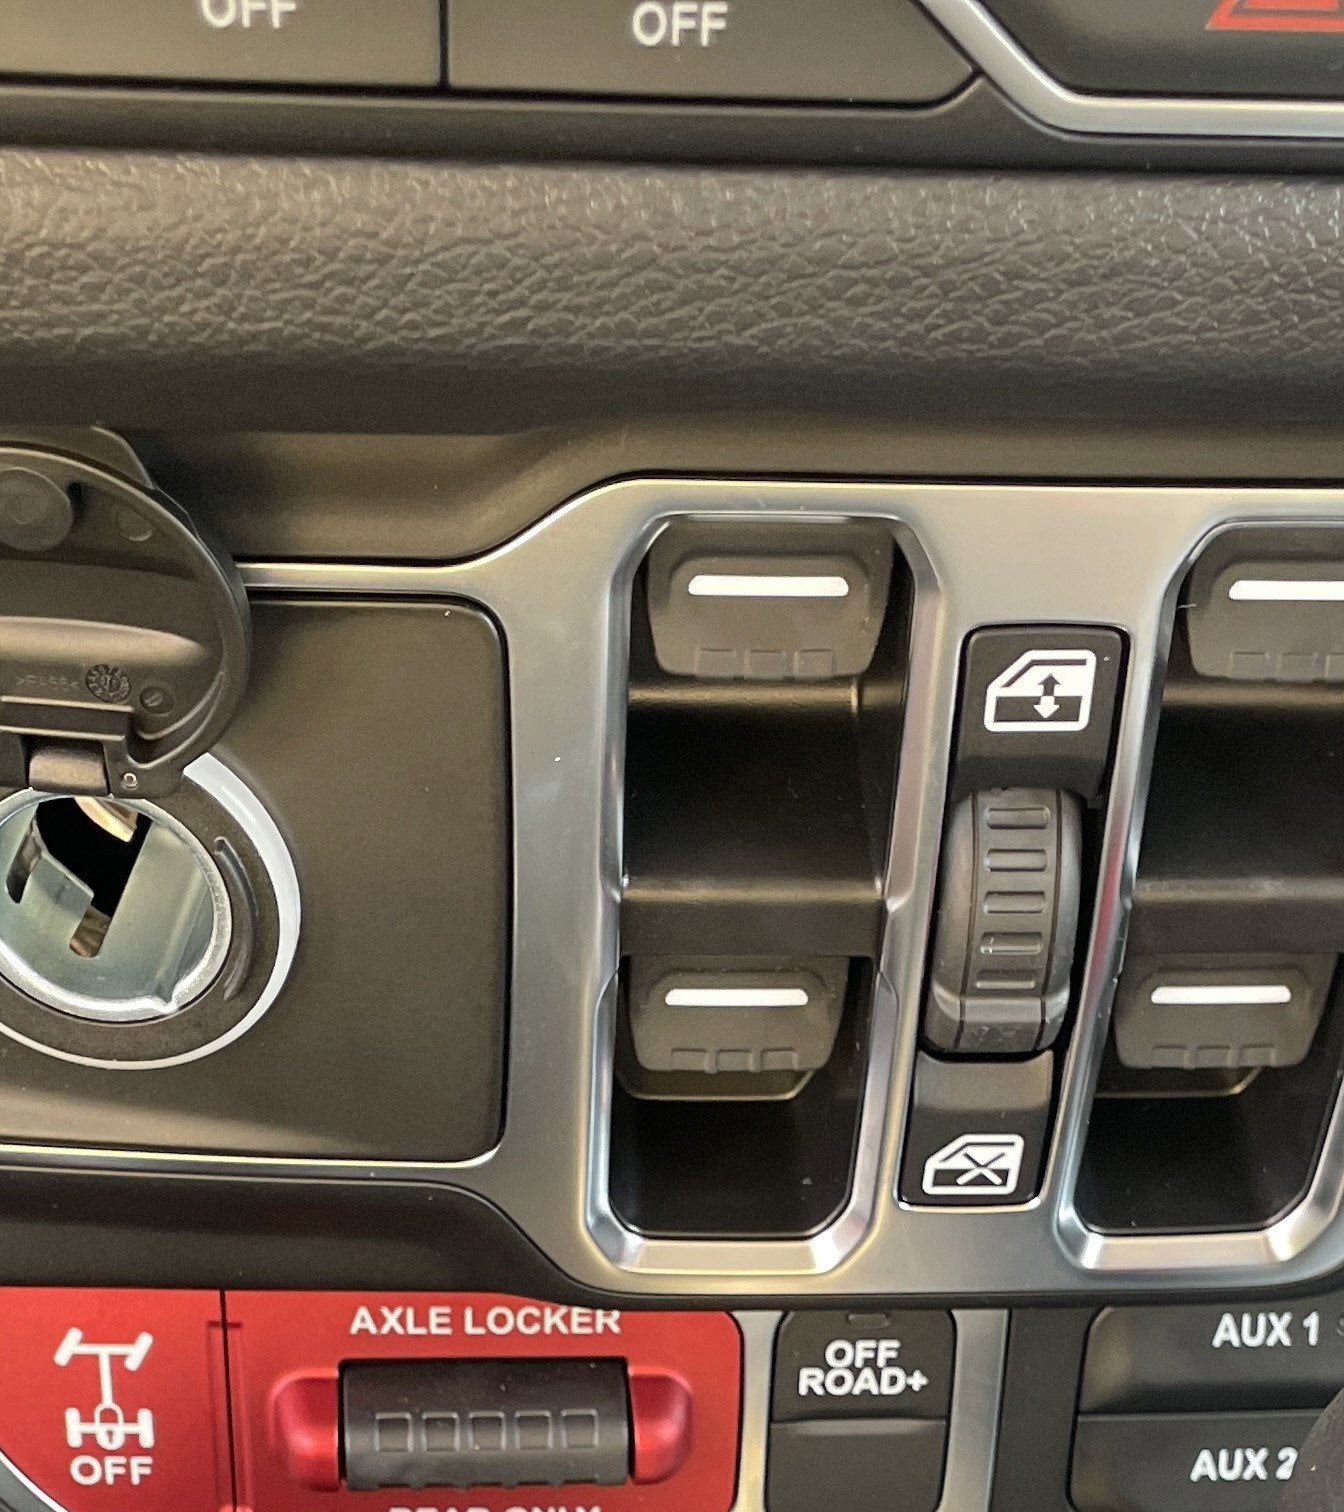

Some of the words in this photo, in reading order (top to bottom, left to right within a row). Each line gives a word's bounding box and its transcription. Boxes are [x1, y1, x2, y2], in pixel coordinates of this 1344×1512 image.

[202, 0, 296, 28] OFF
[632, 1, 728, 46] OFF
[349, 1306, 453, 1335] AXLE
[464, 1306, 620, 1335] LOCKER
[1212, 1312, 1293, 1348] AUX
[1303, 1311, 1320, 1346] 1
[824, 1340, 900, 1369] OFF
[798, 1367, 928, 1397] ROAD+
[70, 1455, 153, 1485] OFF
[1190, 1448, 1269, 1482] AUX
[1275, 1447, 1298, 1480] 2
